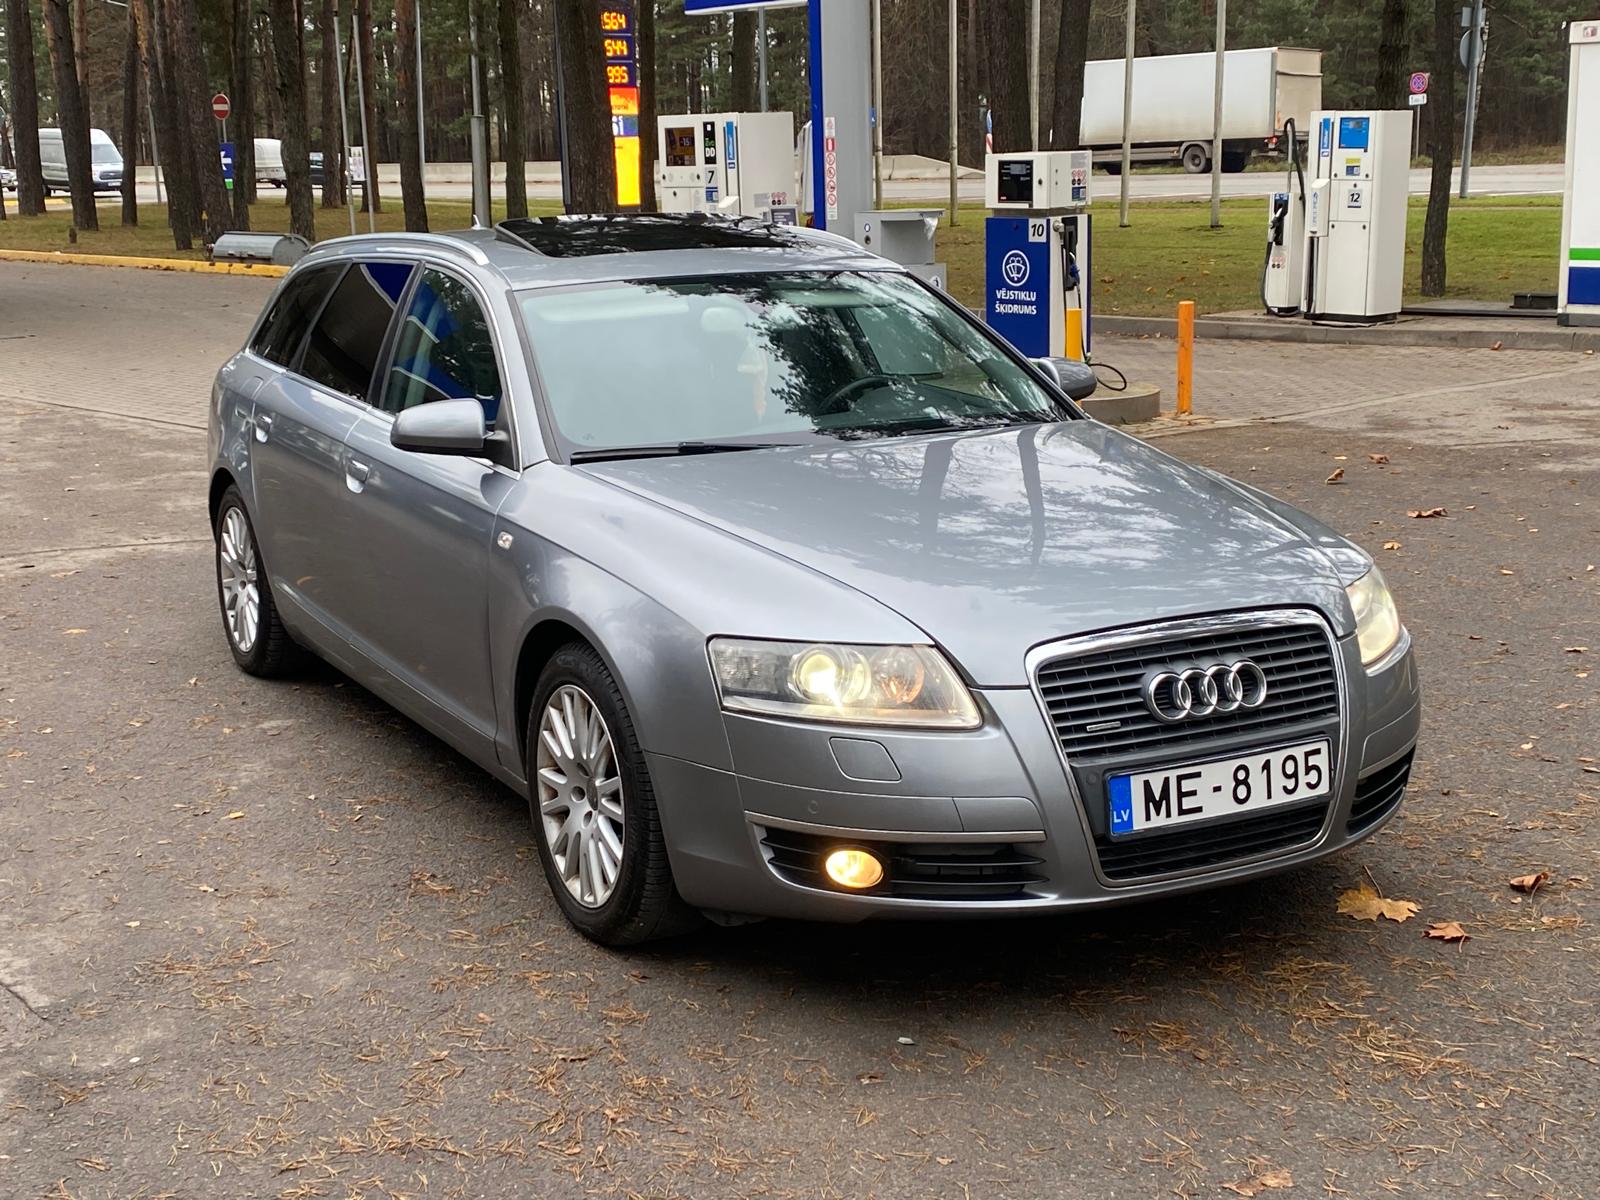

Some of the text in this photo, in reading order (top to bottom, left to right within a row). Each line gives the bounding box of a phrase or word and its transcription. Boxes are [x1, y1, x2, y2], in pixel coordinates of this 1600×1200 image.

[708, 170, 715, 184] 7
[1350, 193, 1360, 203] 12
[1031, 224, 1044, 237] 10
[996, 288, 1036, 301] VĒJSTIKLU
[995, 301, 1037, 315] ŠĶIDRUMS
[1143, 747, 1322, 822] ME-8195
[1113, 809, 1130, 823] LV
